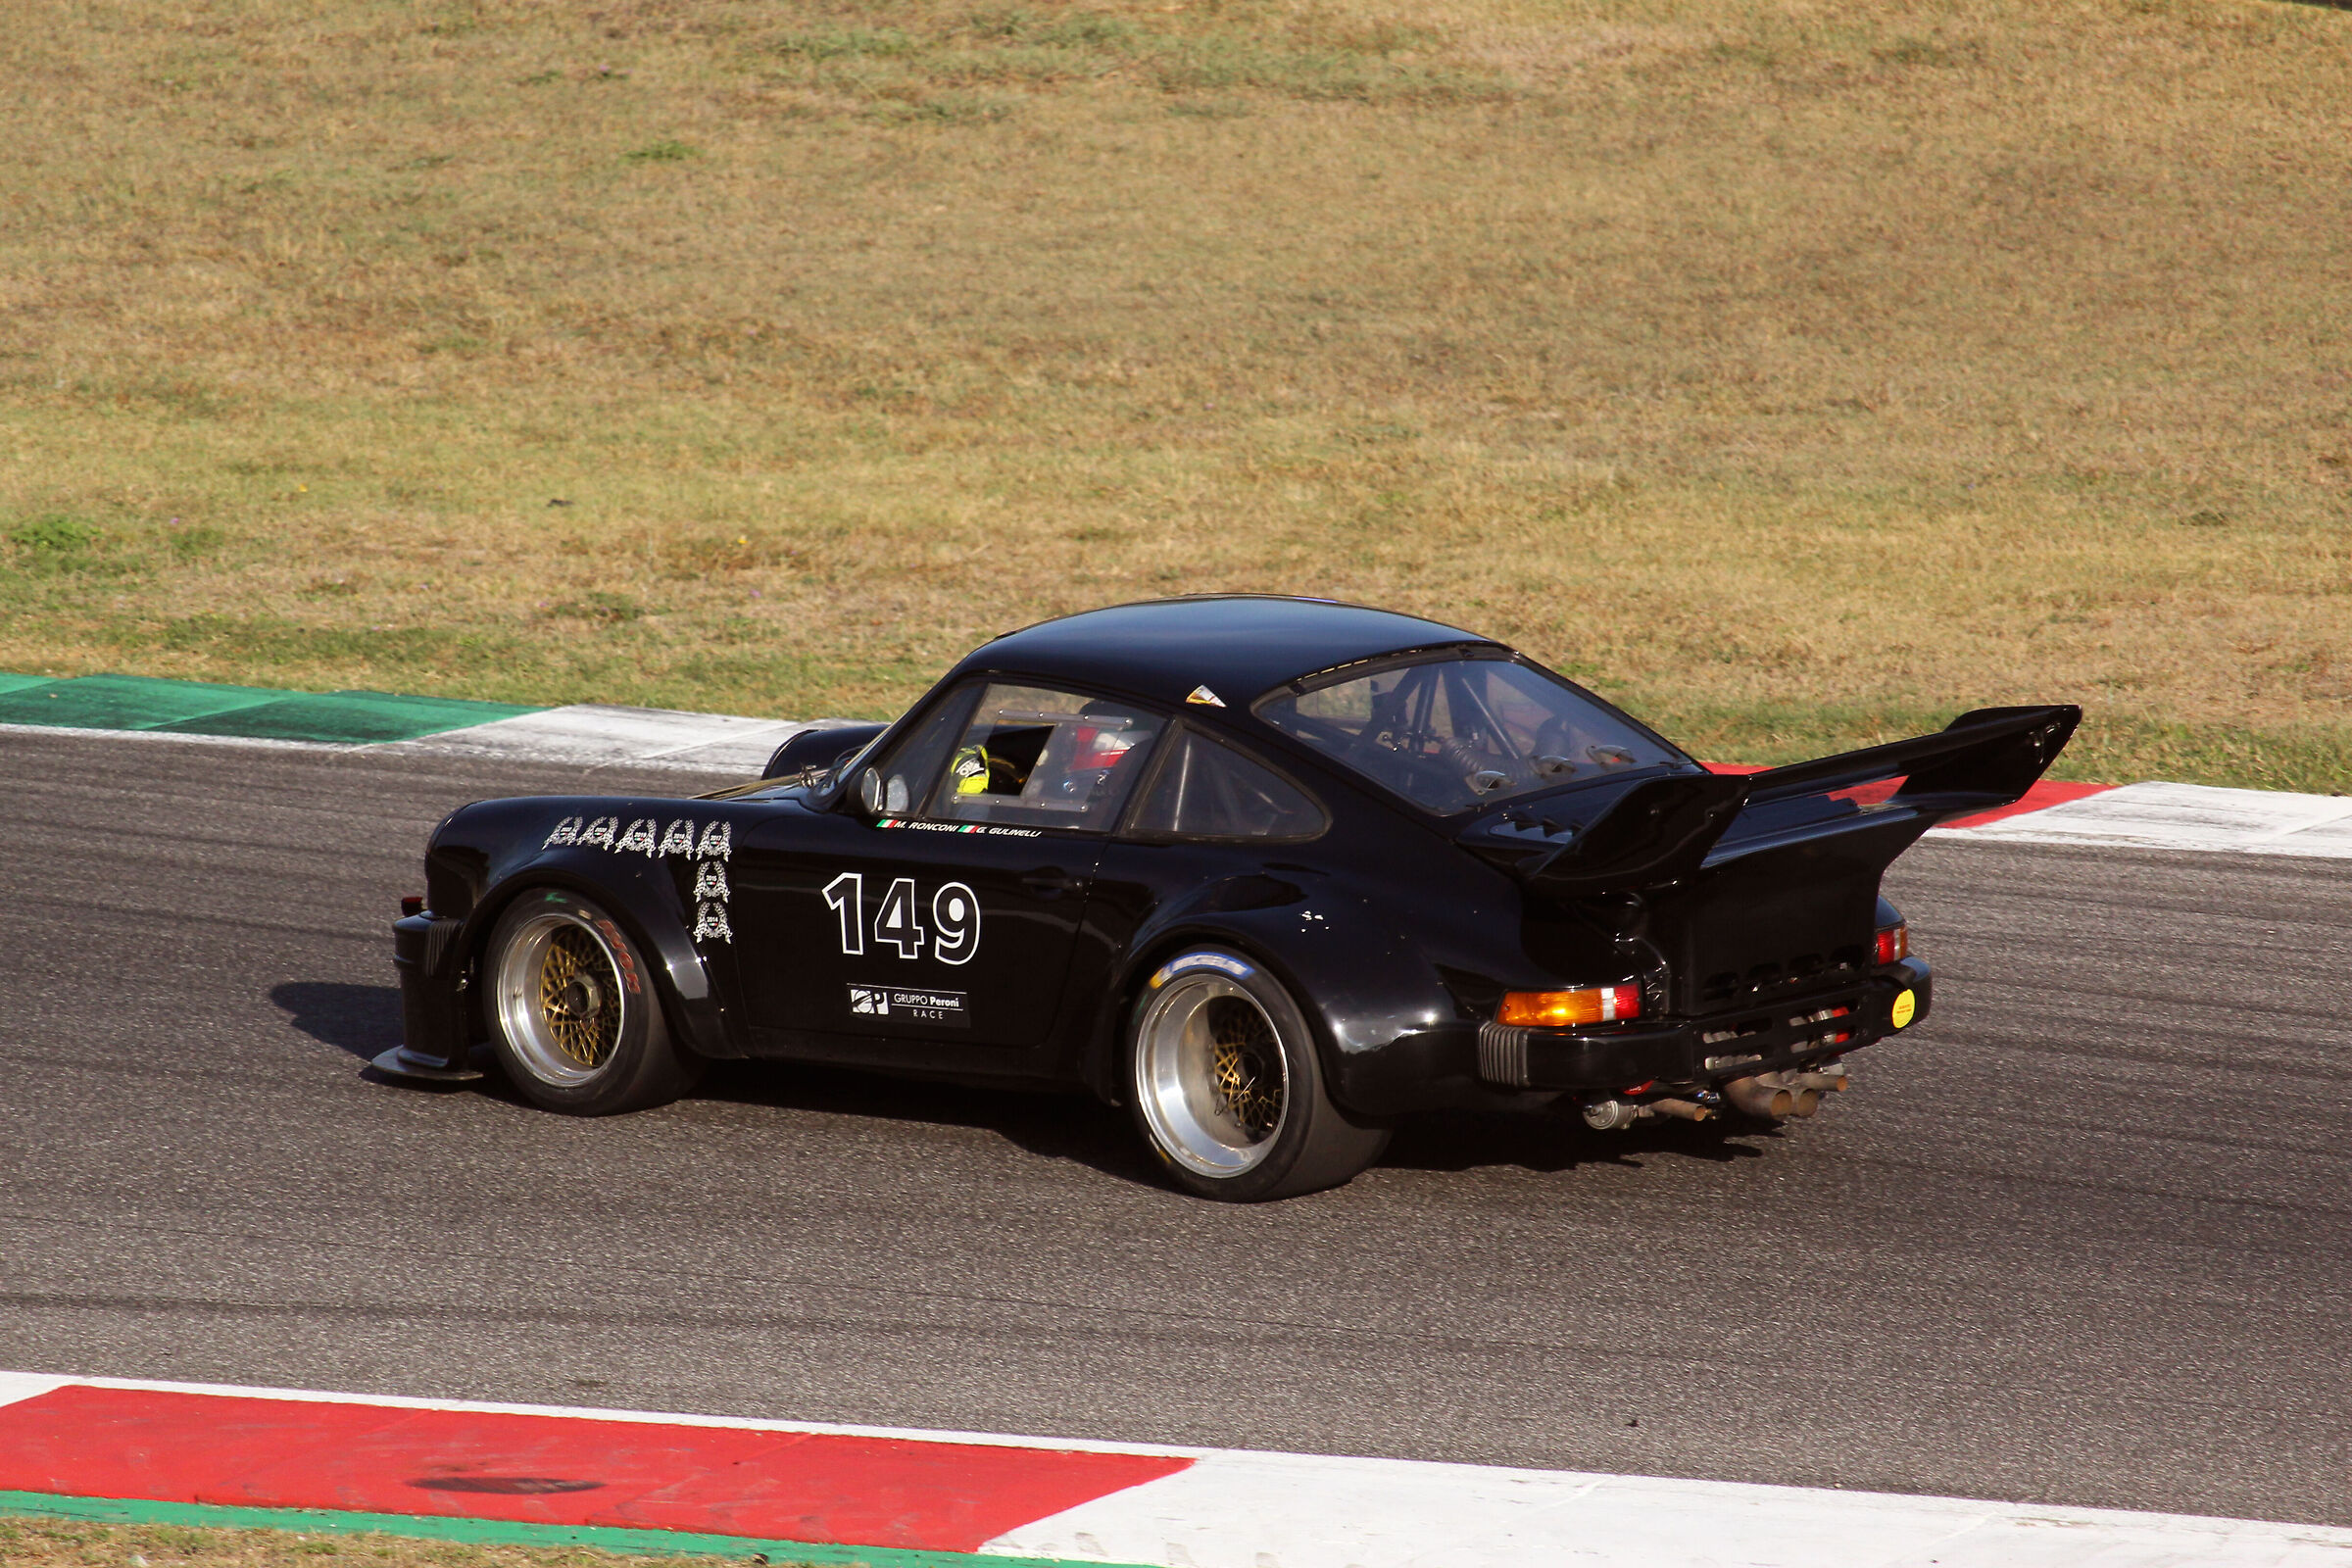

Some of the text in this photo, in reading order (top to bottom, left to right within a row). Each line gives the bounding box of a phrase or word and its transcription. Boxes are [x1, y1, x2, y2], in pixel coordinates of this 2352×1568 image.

[894, 820, 959, 832] M. RONCONI
[989, 827, 1042, 838] GULINELLI
[821, 872, 981, 965] 149
[894, 993, 959, 1007] GRUPPO Peroni
[912, 1008, 944, 1019] RACE
